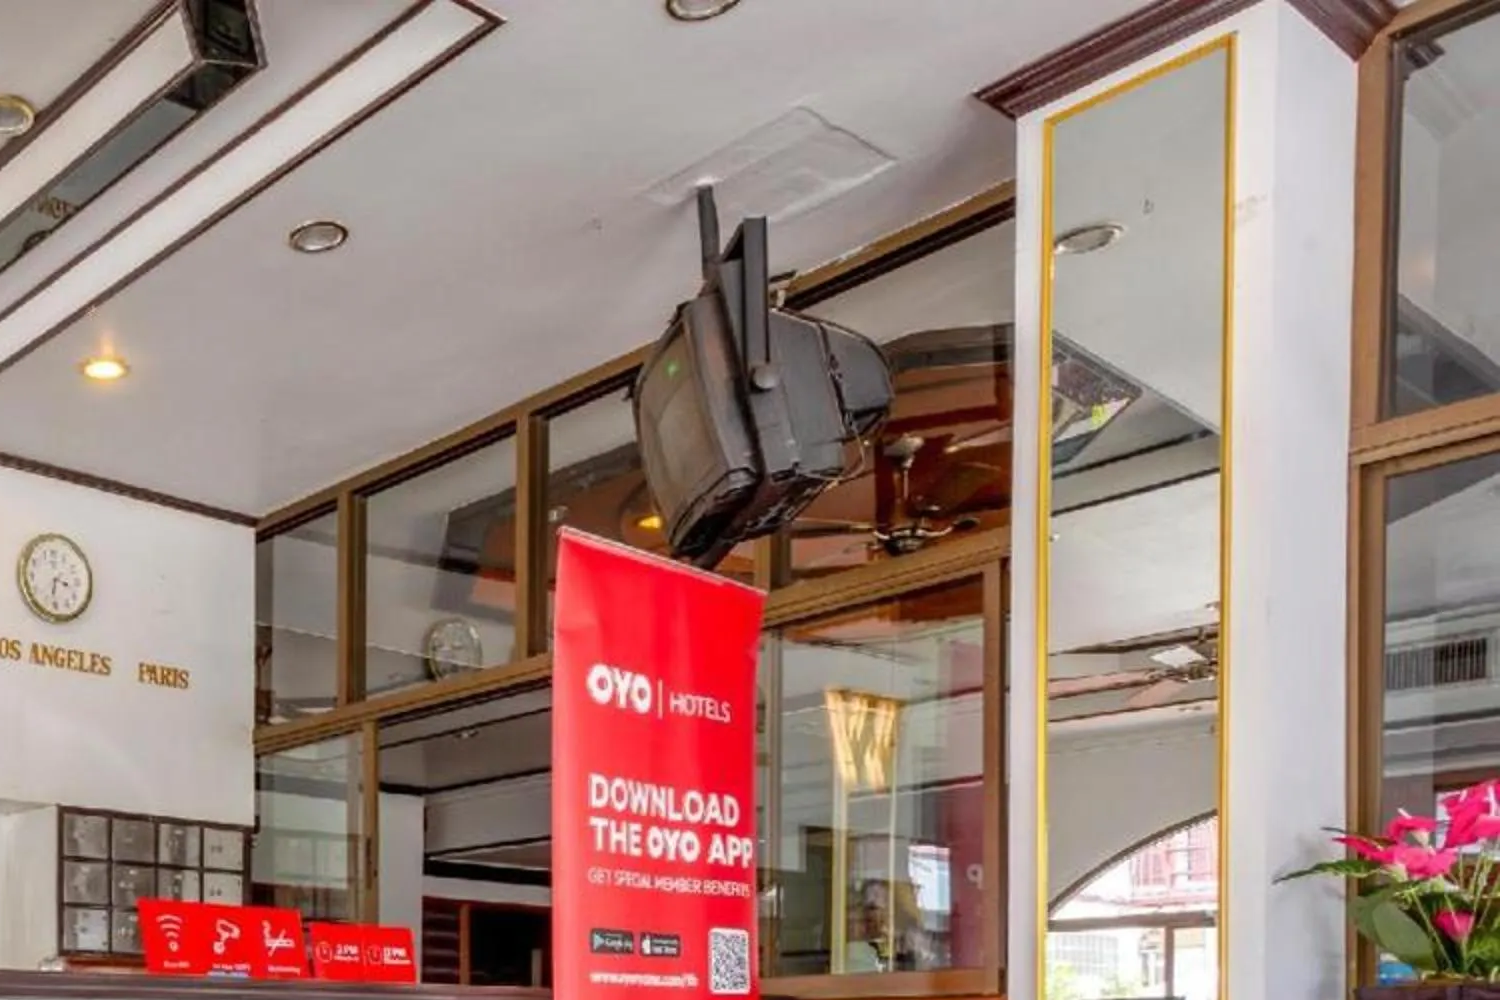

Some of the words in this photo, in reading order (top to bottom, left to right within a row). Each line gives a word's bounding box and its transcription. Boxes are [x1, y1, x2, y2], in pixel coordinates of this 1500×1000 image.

[28, 643, 112, 675] ANGELES
[138, 662, 190, 689] PARIS
[587, 664, 652, 715] OYO
[669, 692, 732, 723] HOTELS
[588, 774, 740, 827] DOWNLOAD
[589, 817, 642, 856] THE
[647, 830, 700, 862] OYO
[707, 834, 753, 869] APP
[588, 867, 610, 885] GET
[614, 869, 652, 889] SPECIAL
[655, 875, 702, 894] MEMBER
